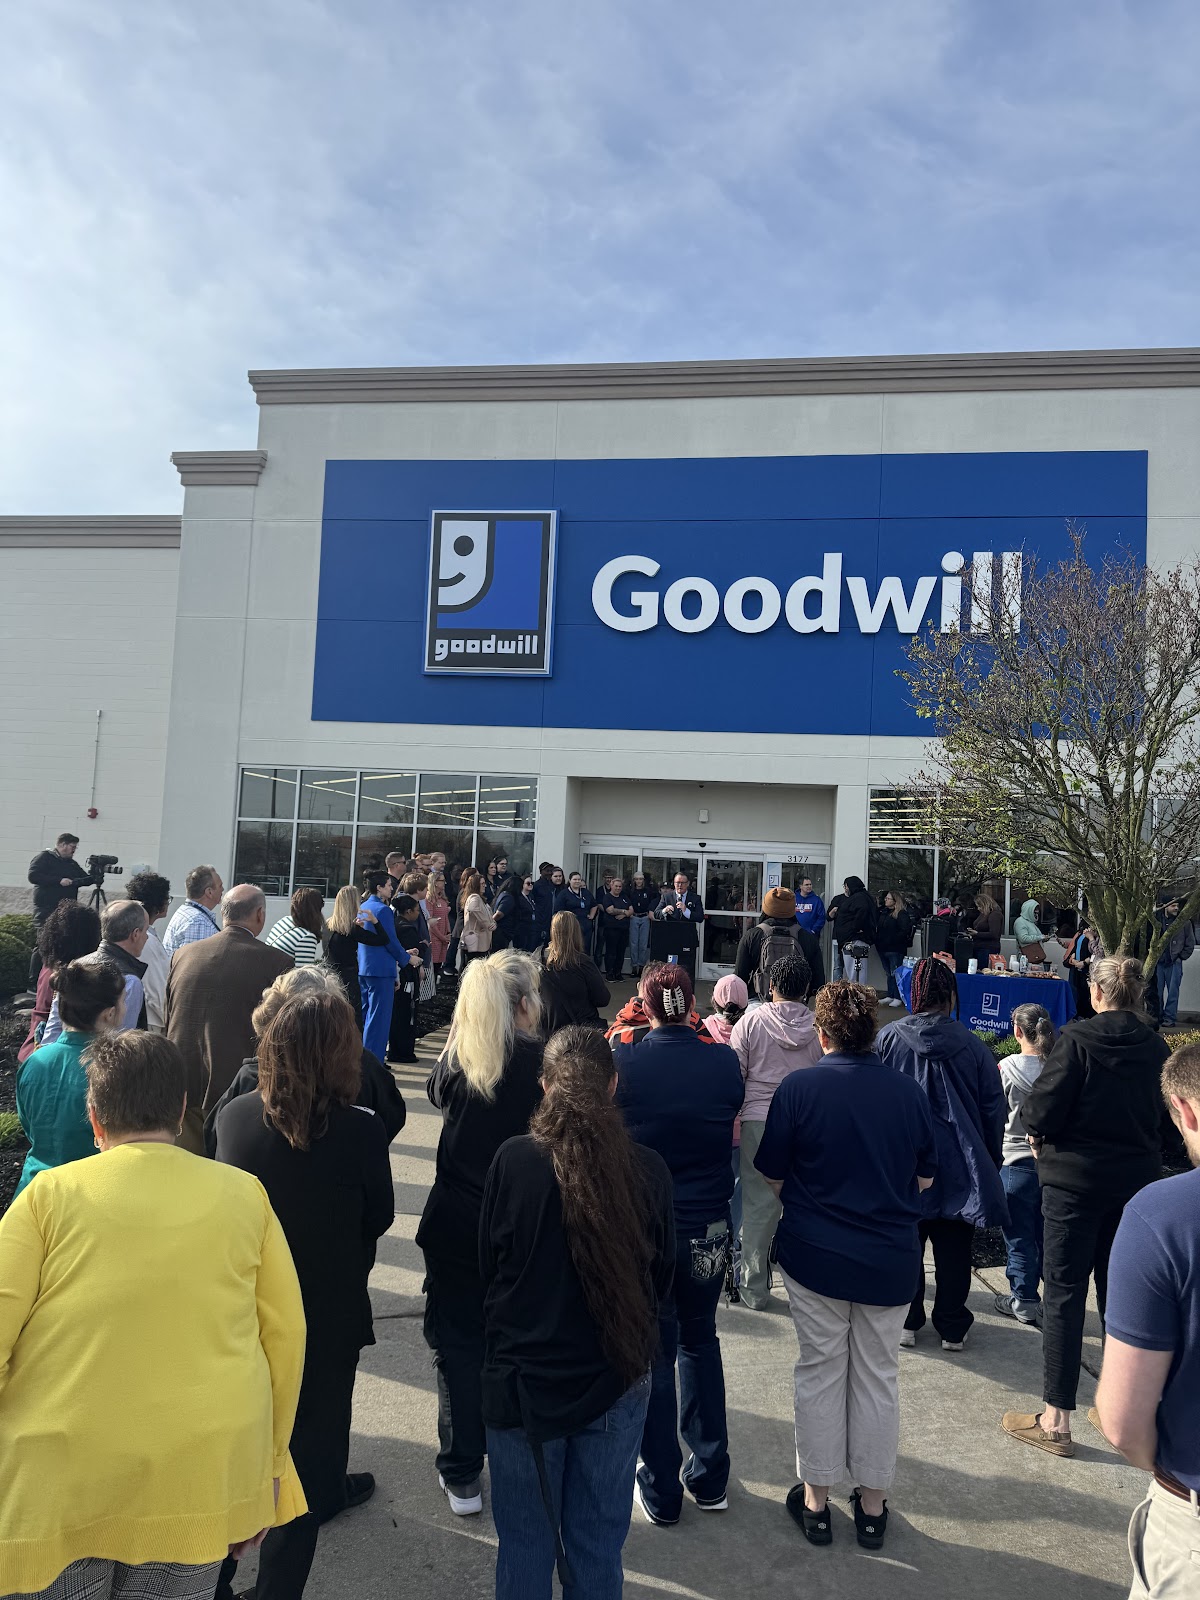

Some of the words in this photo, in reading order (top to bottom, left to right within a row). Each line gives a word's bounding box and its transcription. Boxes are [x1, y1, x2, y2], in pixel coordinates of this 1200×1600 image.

[592, 551, 1022, 633] Goodwill
[435, 635, 538, 661] goodwill
[787, 855, 809, 863] 3177
[970, 1016, 1009, 1029] Goodwill
